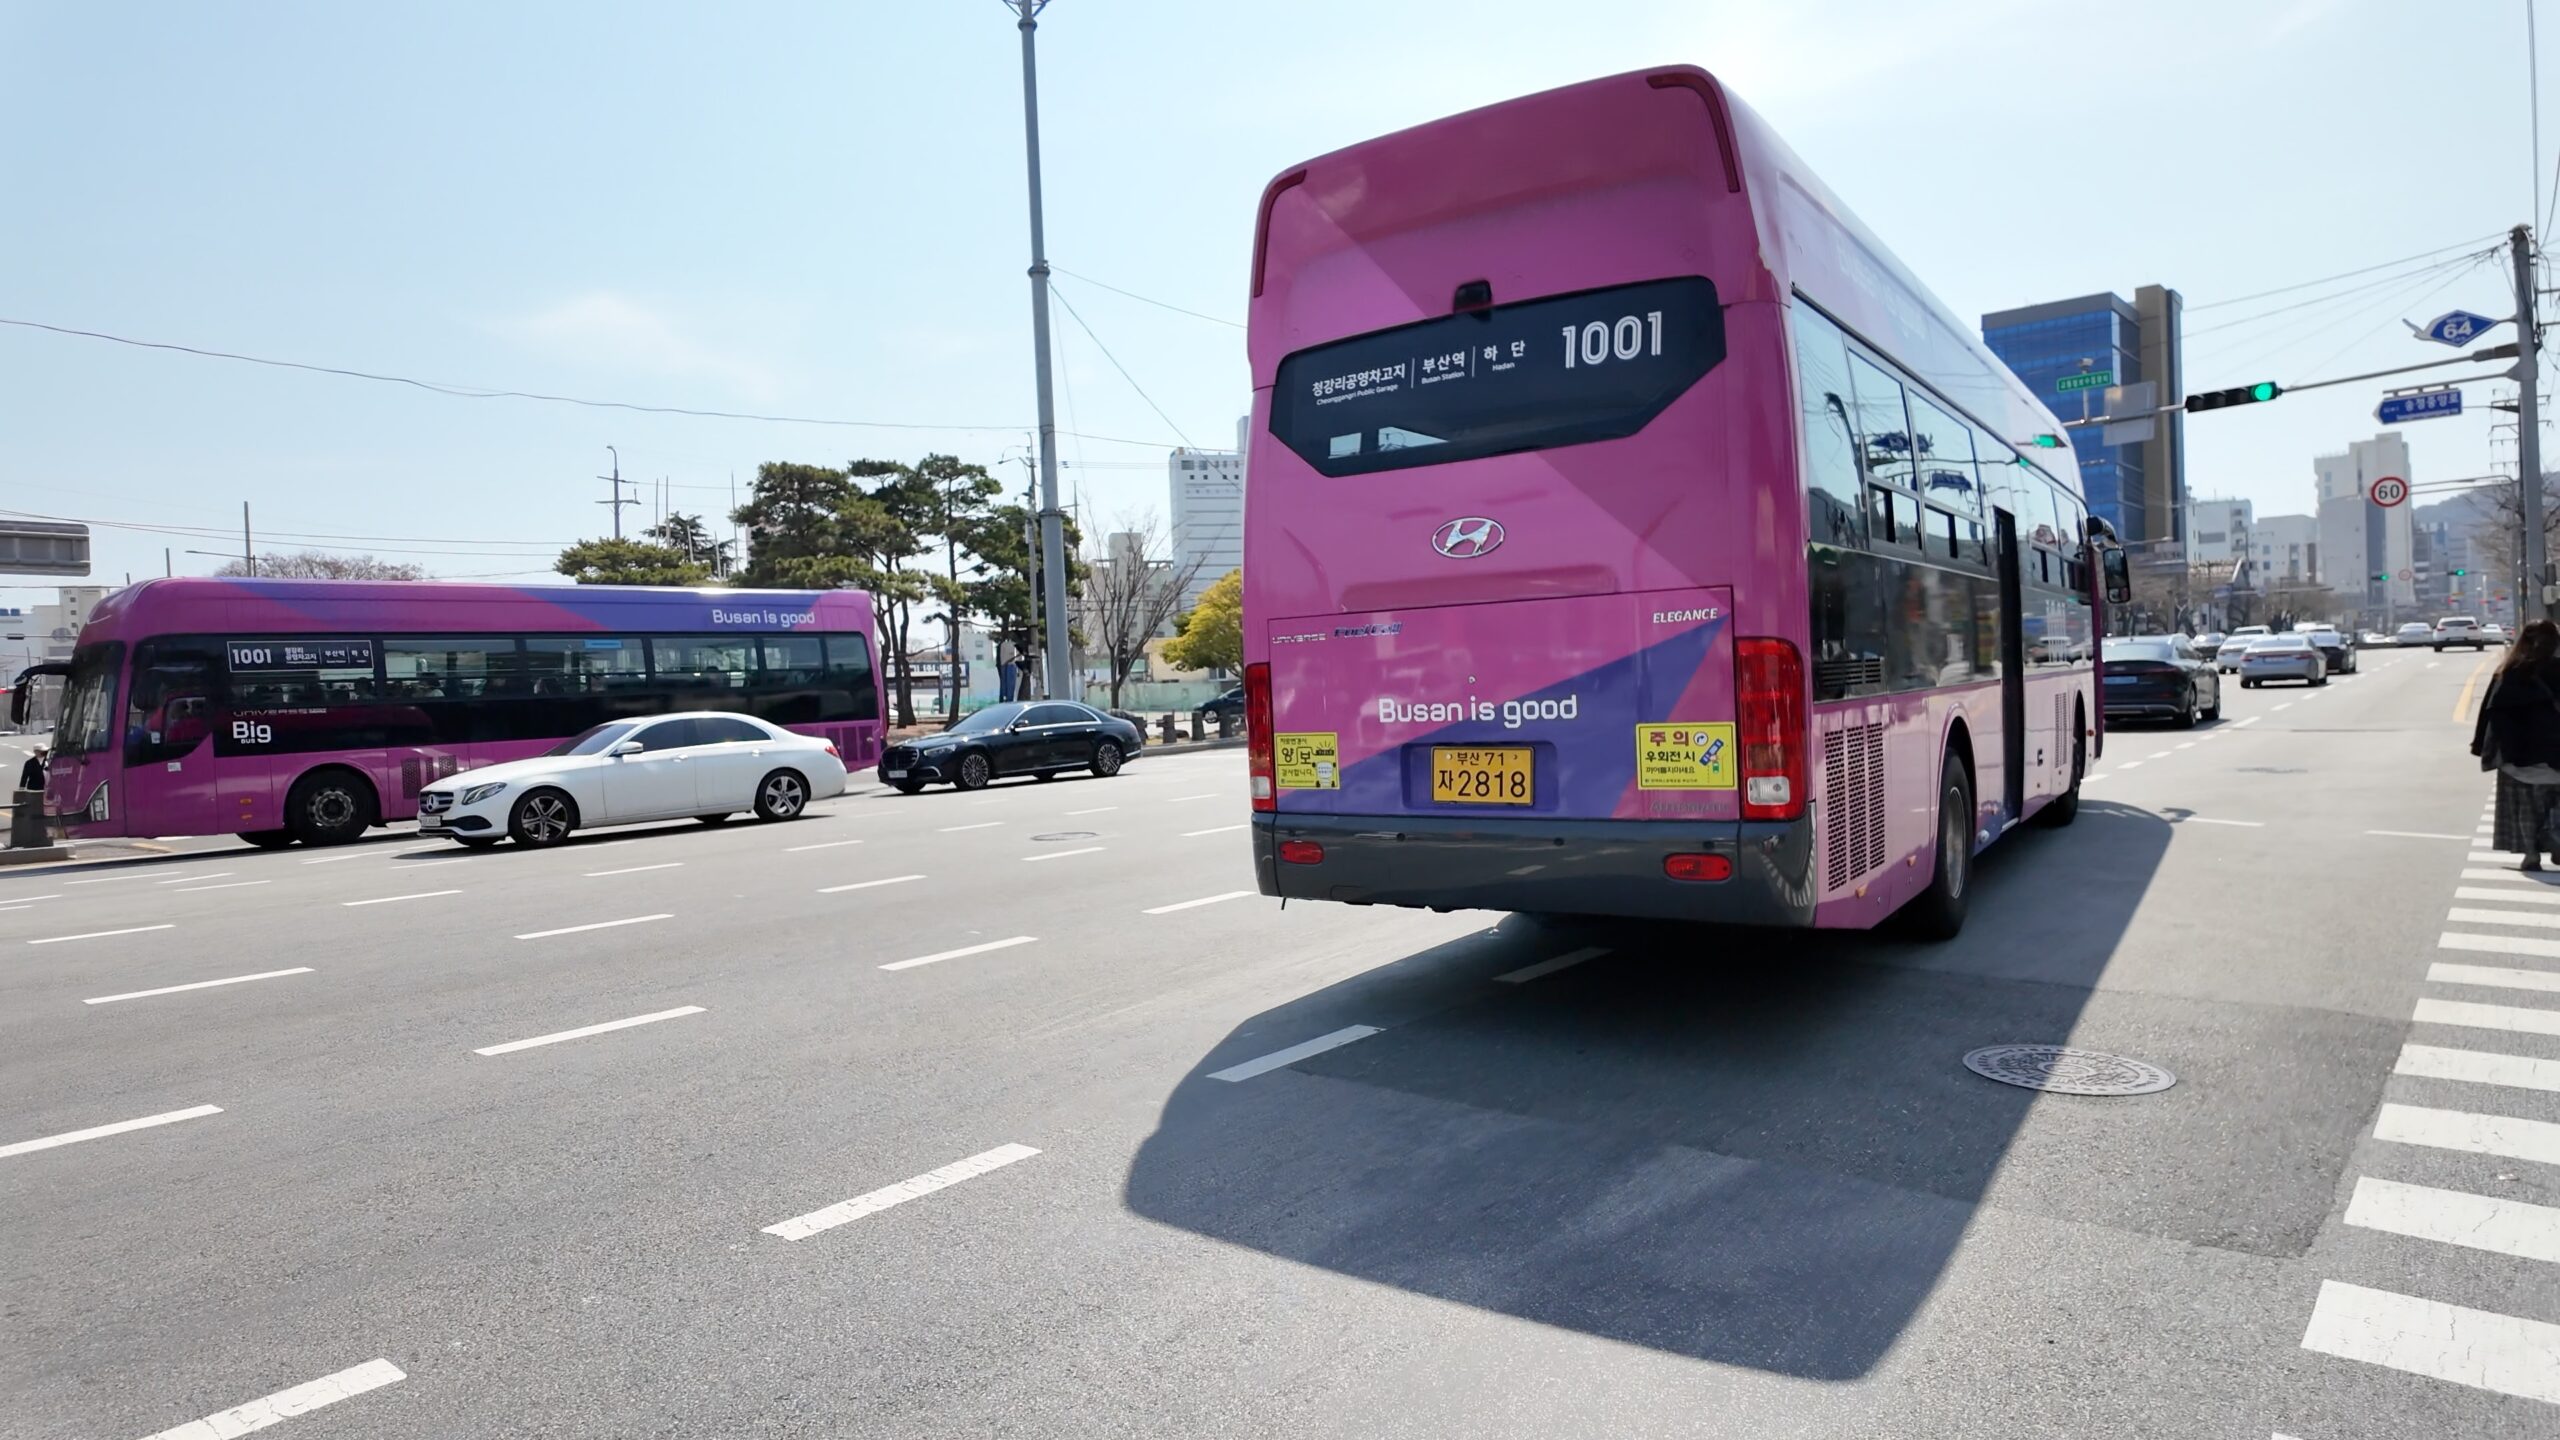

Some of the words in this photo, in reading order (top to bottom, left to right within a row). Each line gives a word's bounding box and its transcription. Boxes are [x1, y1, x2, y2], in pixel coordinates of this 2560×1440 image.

[2443, 320, 2473, 339] 64
[1562, 311, 1662, 368] 1001
[1312, 363, 1405, 397] 청강리공영차고지
[1422, 351, 1465, 373] 부산역
[1492, 361, 1515, 372] Hadan
[1421, 374, 1441, 385] Busan
[1442, 370, 1465, 381] Station
[1357, 387, 1375, 398] Public
[1376, 384, 1399, 395] Garage
[2378, 484, 2400, 500] 60
[712, 609, 760, 624] Busan
[763, 609, 777, 624] is
[780, 611, 815, 628] good
[1653, 607, 1718, 624] ELEGANCE
[232, 648, 272, 664] 1001
[1378, 698, 1463, 723] Busan
[1470, 695, 1495, 721] is
[1503, 694, 1578, 728] good
[232, 721, 272, 743] Big
[1457, 752, 1479, 766] 부산
[1485, 752, 1504, 766] 71
[1645, 751, 1681, 762] 우회전
[1684, 751, 1695, 762] 시
